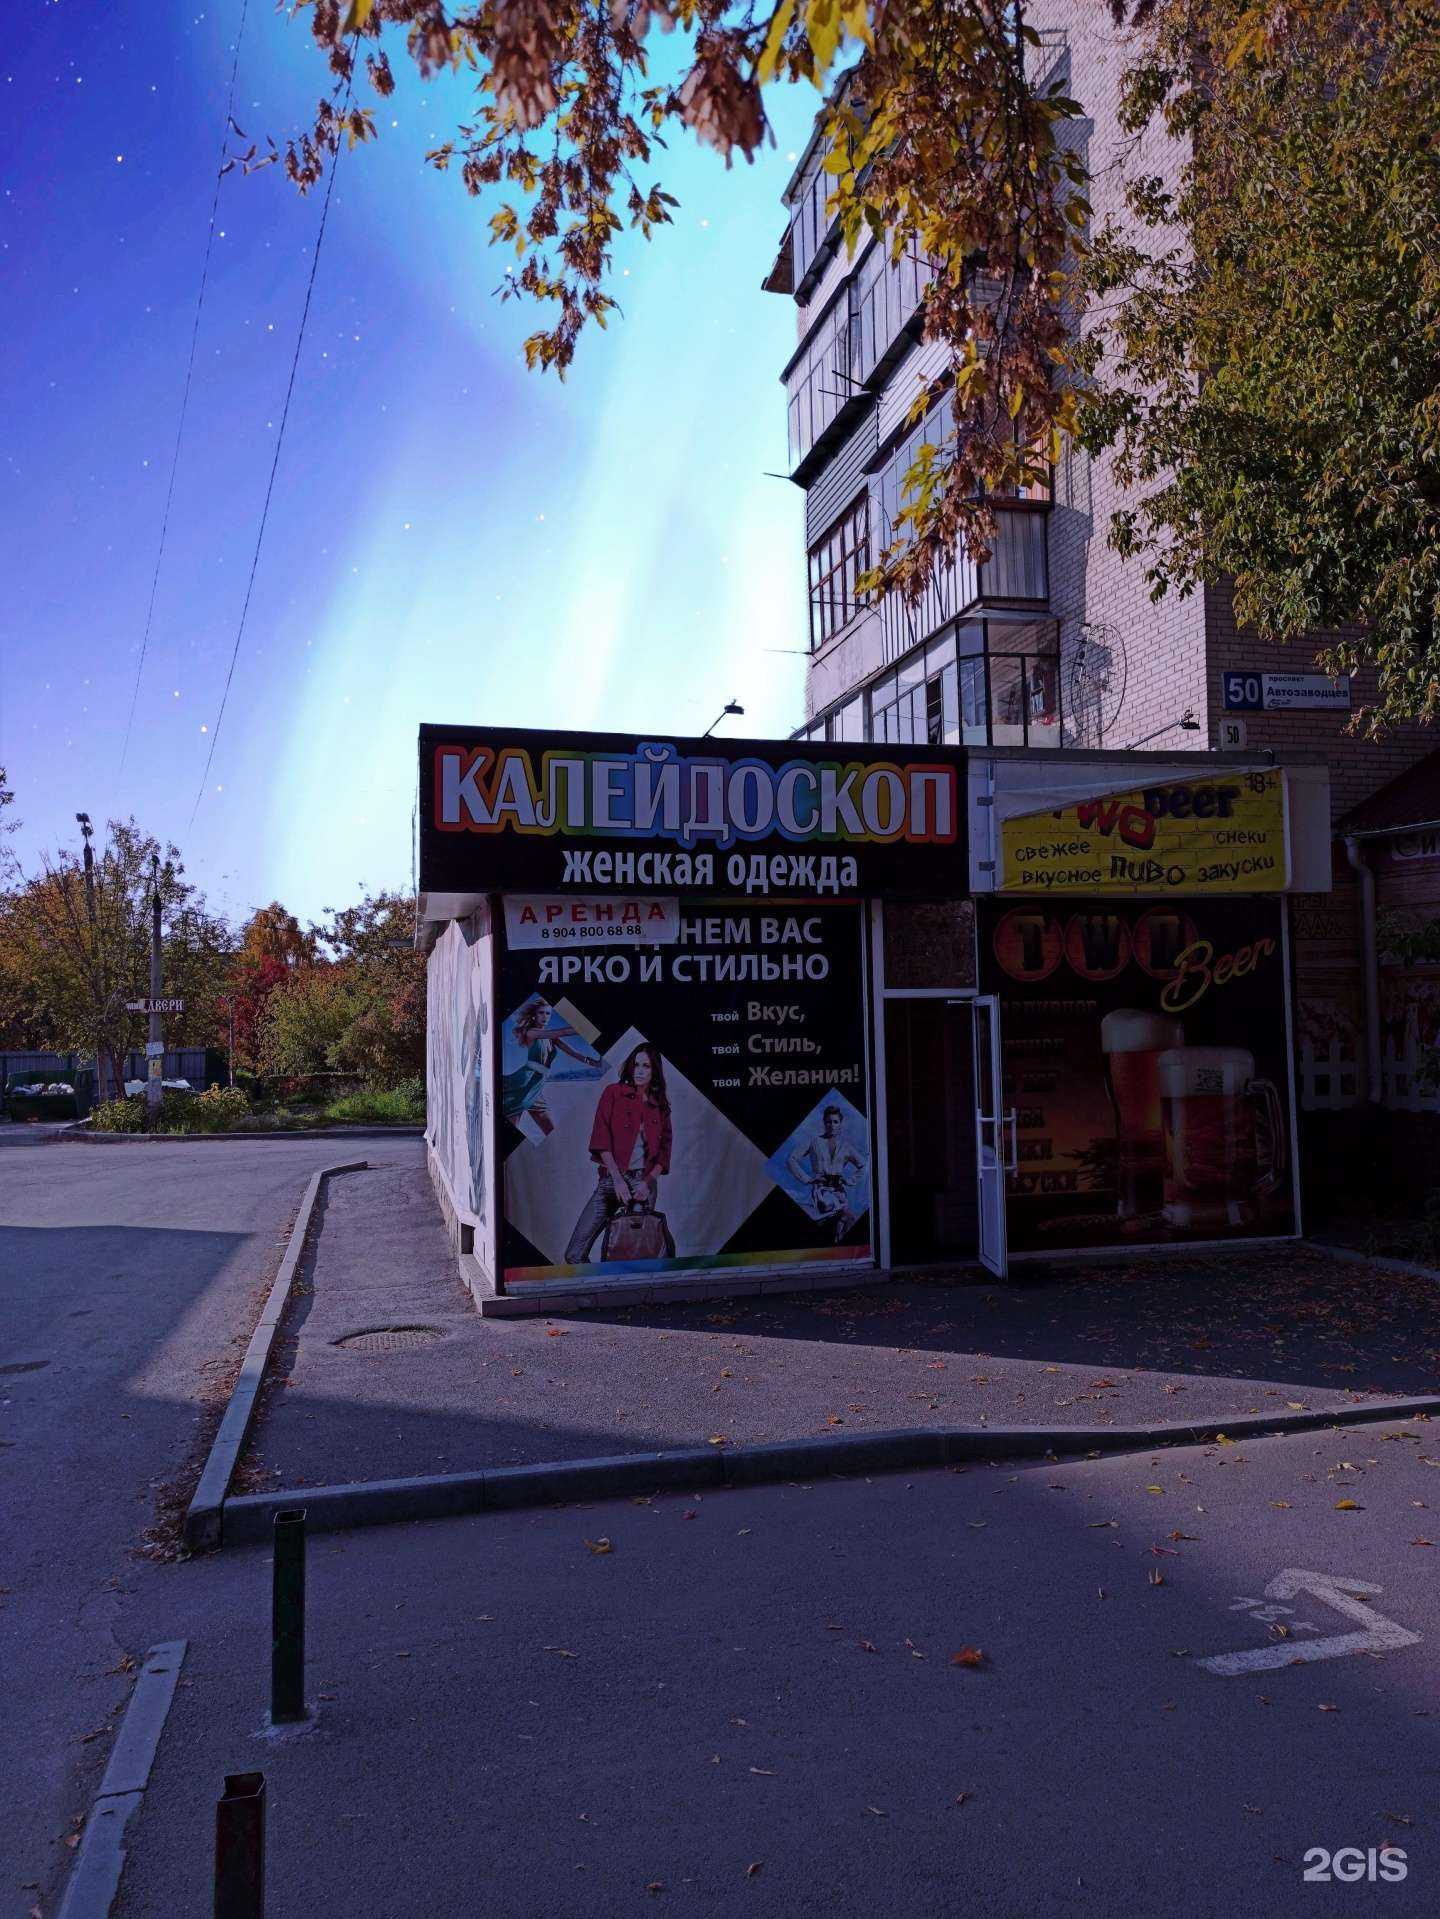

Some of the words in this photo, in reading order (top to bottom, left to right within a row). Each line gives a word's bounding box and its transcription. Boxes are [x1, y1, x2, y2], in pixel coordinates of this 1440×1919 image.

[1228, 677, 1260, 703] 50
[1267, 687, 1348, 698] Автозаводцев
[1227, 726, 1240, 743] 50
[437, 744, 955, 844] КАЛЕЙДОСКОП
[1215, 828, 1267, 845] снеки
[1015, 840, 1090, 862] свежее
[727, 854, 859, 894] одежда
[1022, 867, 1101, 887] вкусное
[1198, 854, 1275, 882] закуски
[520, 902, 666, 925] АРЕНДА
[541, 928, 549, 939] 8
[553, 927, 577, 938] 904
[580, 926, 604, 937] 800
[607, 926, 623, 936] 68
[626, 925, 642, 935] 88
[760, 916, 823, 944] ВАС
[538, 955, 631, 984] ЯРКО
[640, 956, 663, 983] И
[671, 953, 830, 983] СТИЛЬНО
[1160, 936, 1278, 1013] Beer
[711, 1011, 739, 1022] твой
[747, 1001, 805, 1026] Вкус,
[712, 1044, 740, 1055] твой
[748, 1033, 822, 1055] Стиль,
[749, 1064, 861, 1087] Желания!
